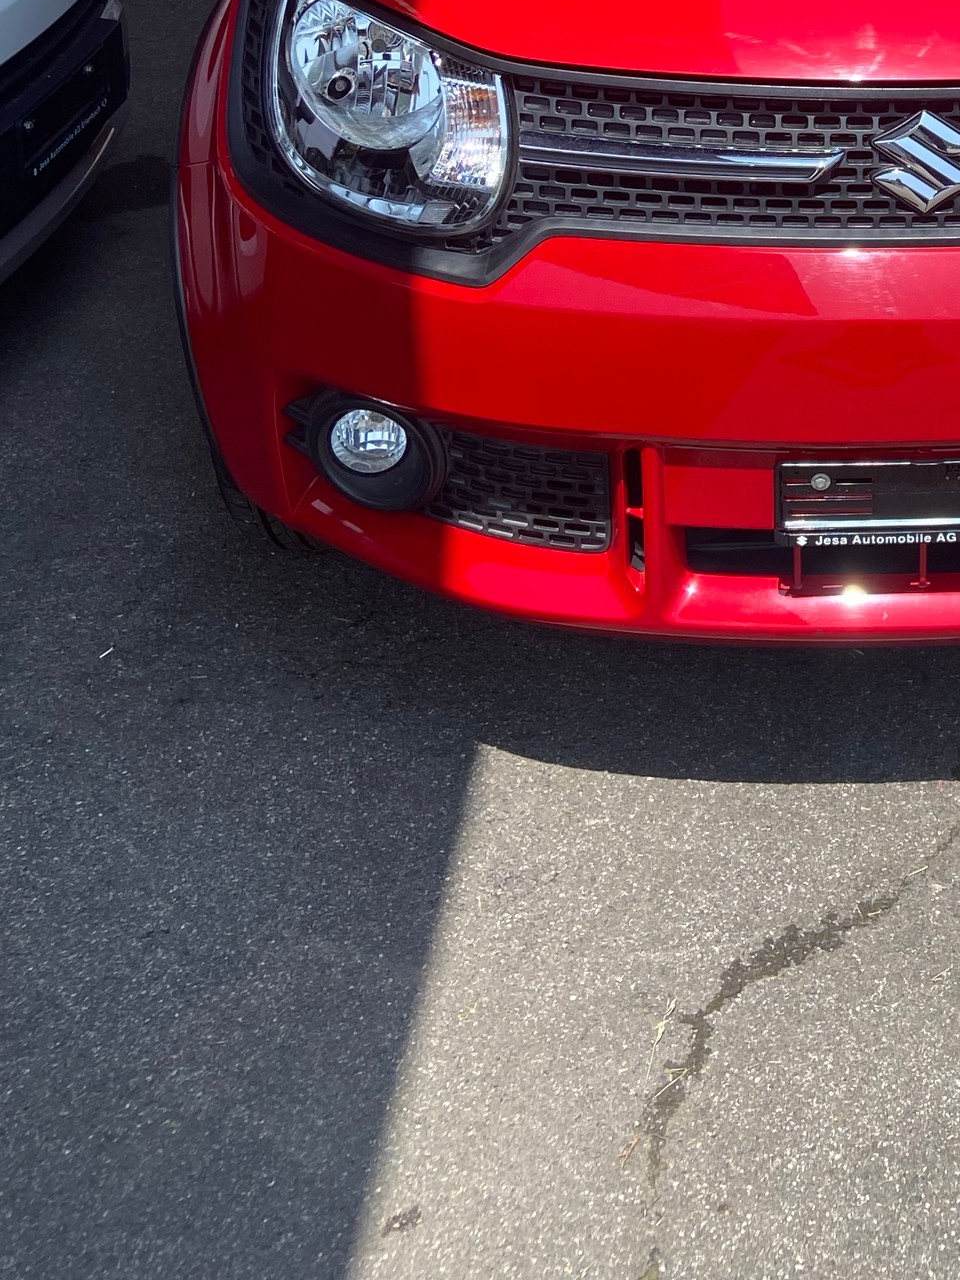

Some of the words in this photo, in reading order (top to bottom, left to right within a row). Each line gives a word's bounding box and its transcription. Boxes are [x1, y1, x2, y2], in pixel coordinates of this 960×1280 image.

[815, 535, 848, 546] Jesa
[852, 533, 932, 545] Automobile
[936, 532, 957, 543] AG
